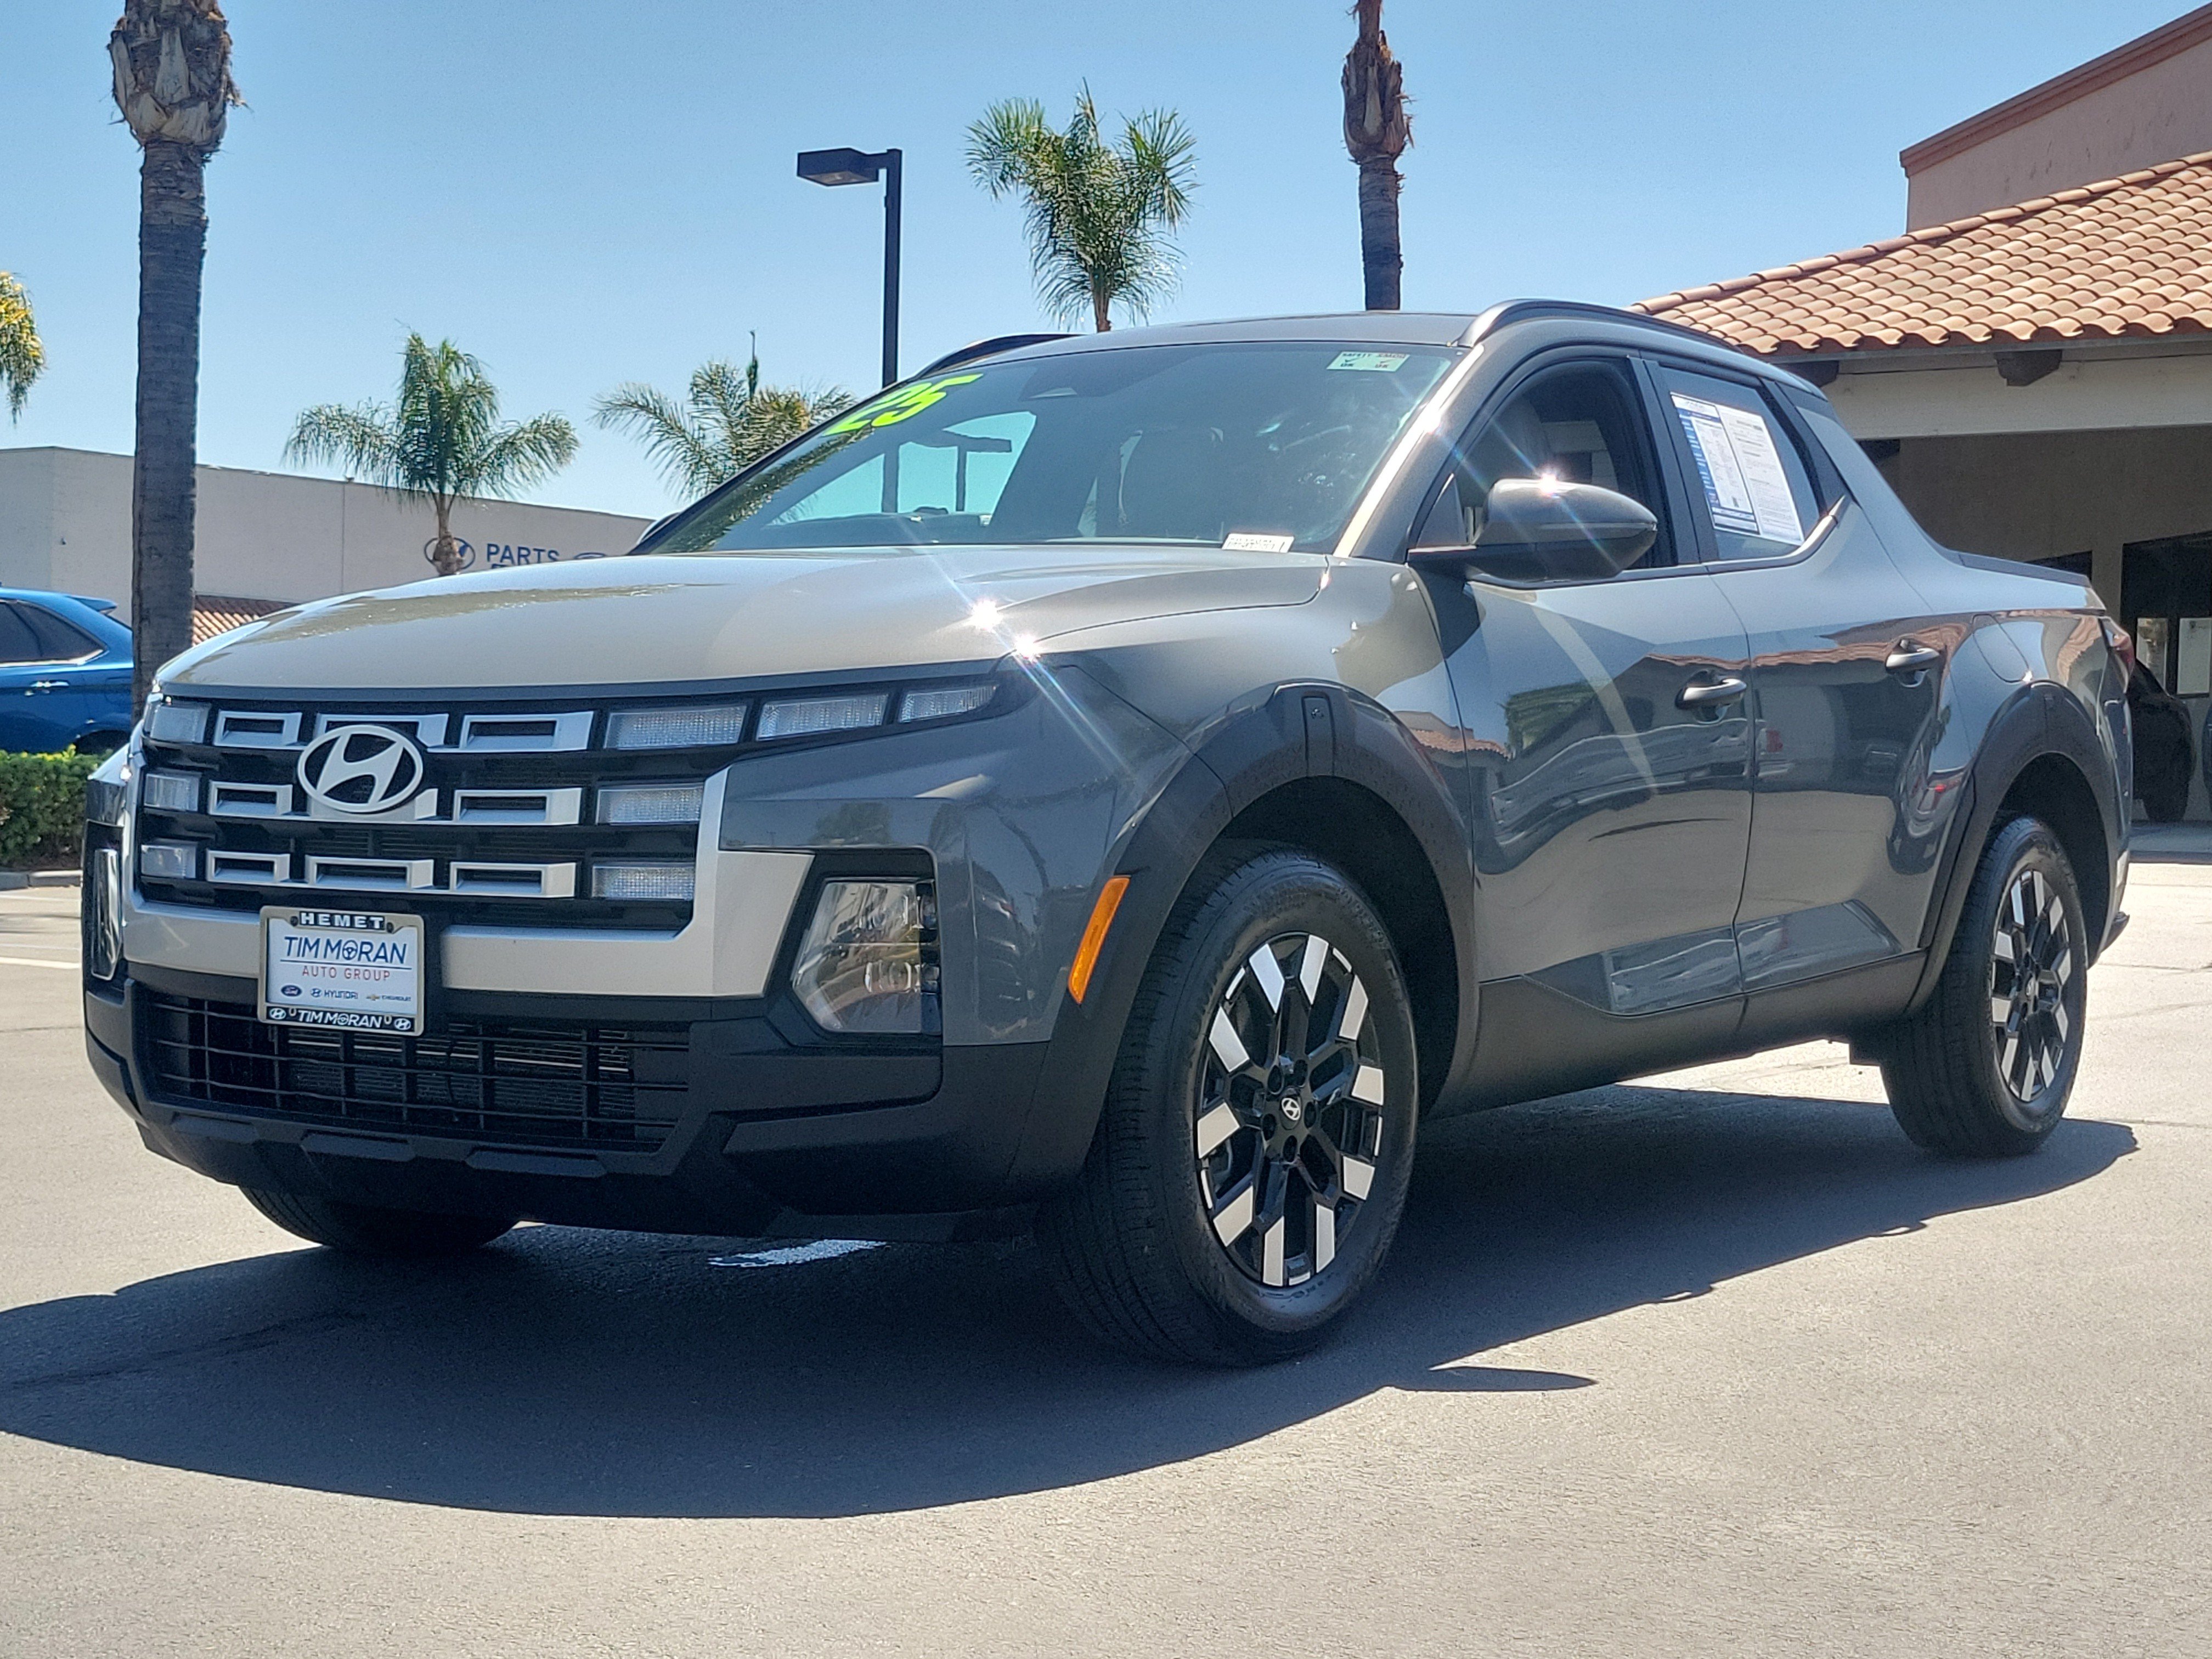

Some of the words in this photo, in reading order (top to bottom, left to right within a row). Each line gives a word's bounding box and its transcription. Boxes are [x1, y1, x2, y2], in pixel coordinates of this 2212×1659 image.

[823, 373, 984, 436] 25
[486, 543, 560, 566] PARTS
[301, 912, 383, 929] HEMET
[284, 936, 320, 958] TIM
[323, 939, 407, 964] MORAN
[302, 965, 337, 979] AUTO
[344, 968, 390, 981] GROUP
[324, 989, 358, 1000] HYUNDAI
[298, 1010, 323, 1023] TIM
[324, 1012, 382, 1028] MORAN
